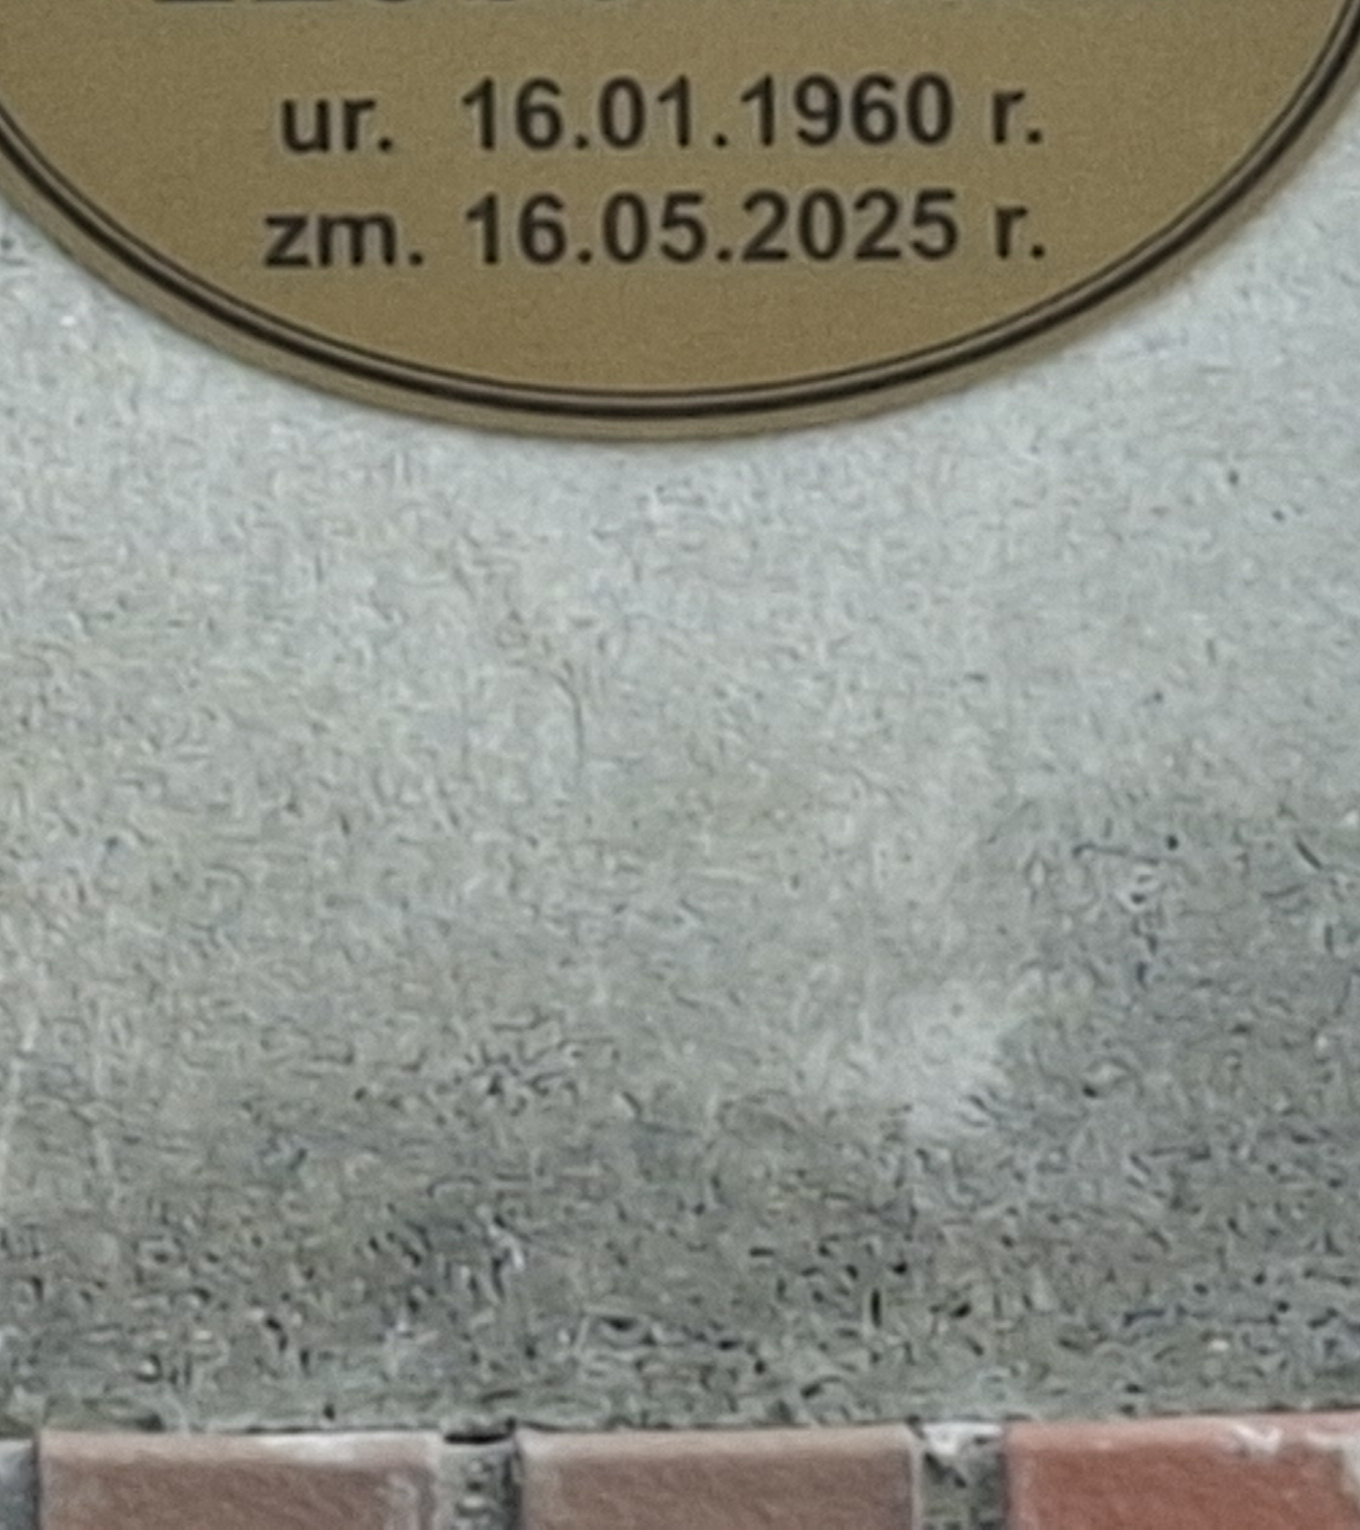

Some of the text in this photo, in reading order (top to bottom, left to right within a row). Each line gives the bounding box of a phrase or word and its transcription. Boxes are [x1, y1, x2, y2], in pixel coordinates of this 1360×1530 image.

[281, 72, 1043, 155] ur. 16.01.1960 r.
[263, 188, 1046, 269] zm. 16.05.2025 r.
